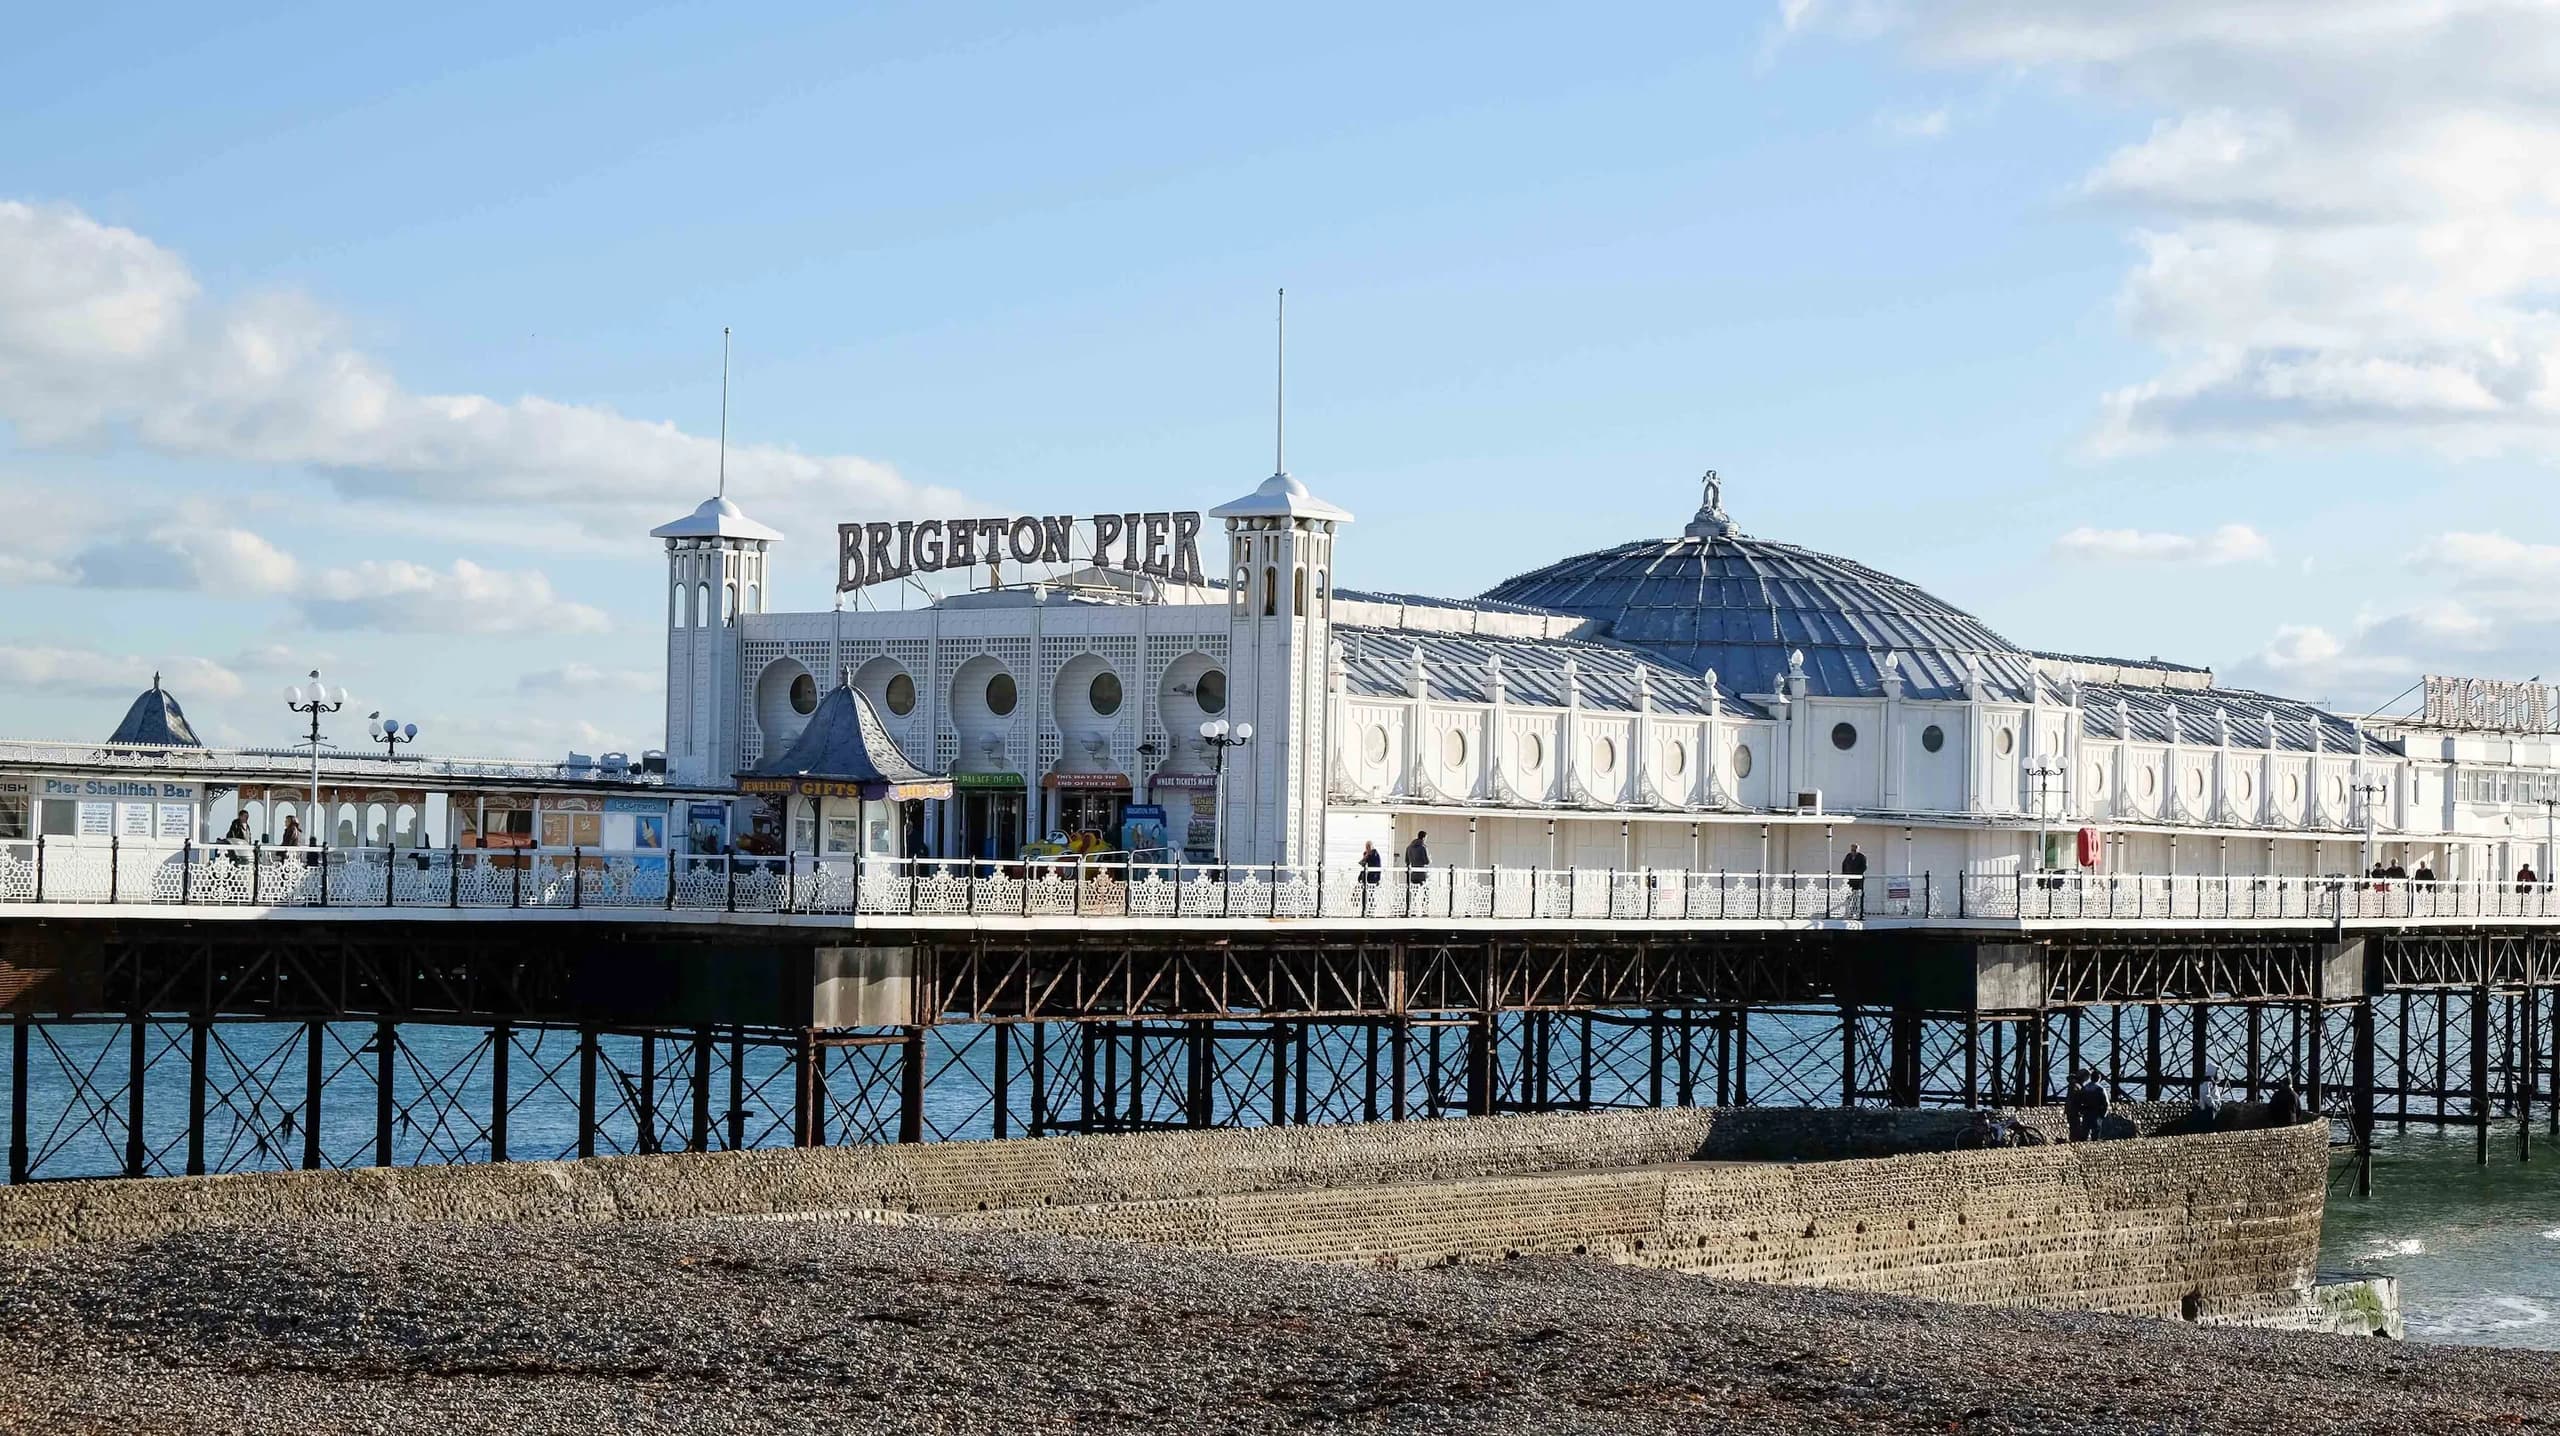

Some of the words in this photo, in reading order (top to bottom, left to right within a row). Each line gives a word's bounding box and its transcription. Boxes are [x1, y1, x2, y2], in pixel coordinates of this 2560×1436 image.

[837, 515, 1073, 592] BRIGHTON
[1092, 511, 1208, 587] PIER
[2423, 674, 2549, 731] BRIGHTON
[45, 779, 79, 794] Pier
[86, 780, 157, 796] Shellfish
[163, 783, 192, 797] Bar
[742, 781, 792, 792] JEWELLERY
[801, 782, 857, 796] GIFTS
[1176, 777, 1197, 786] TICKETS
